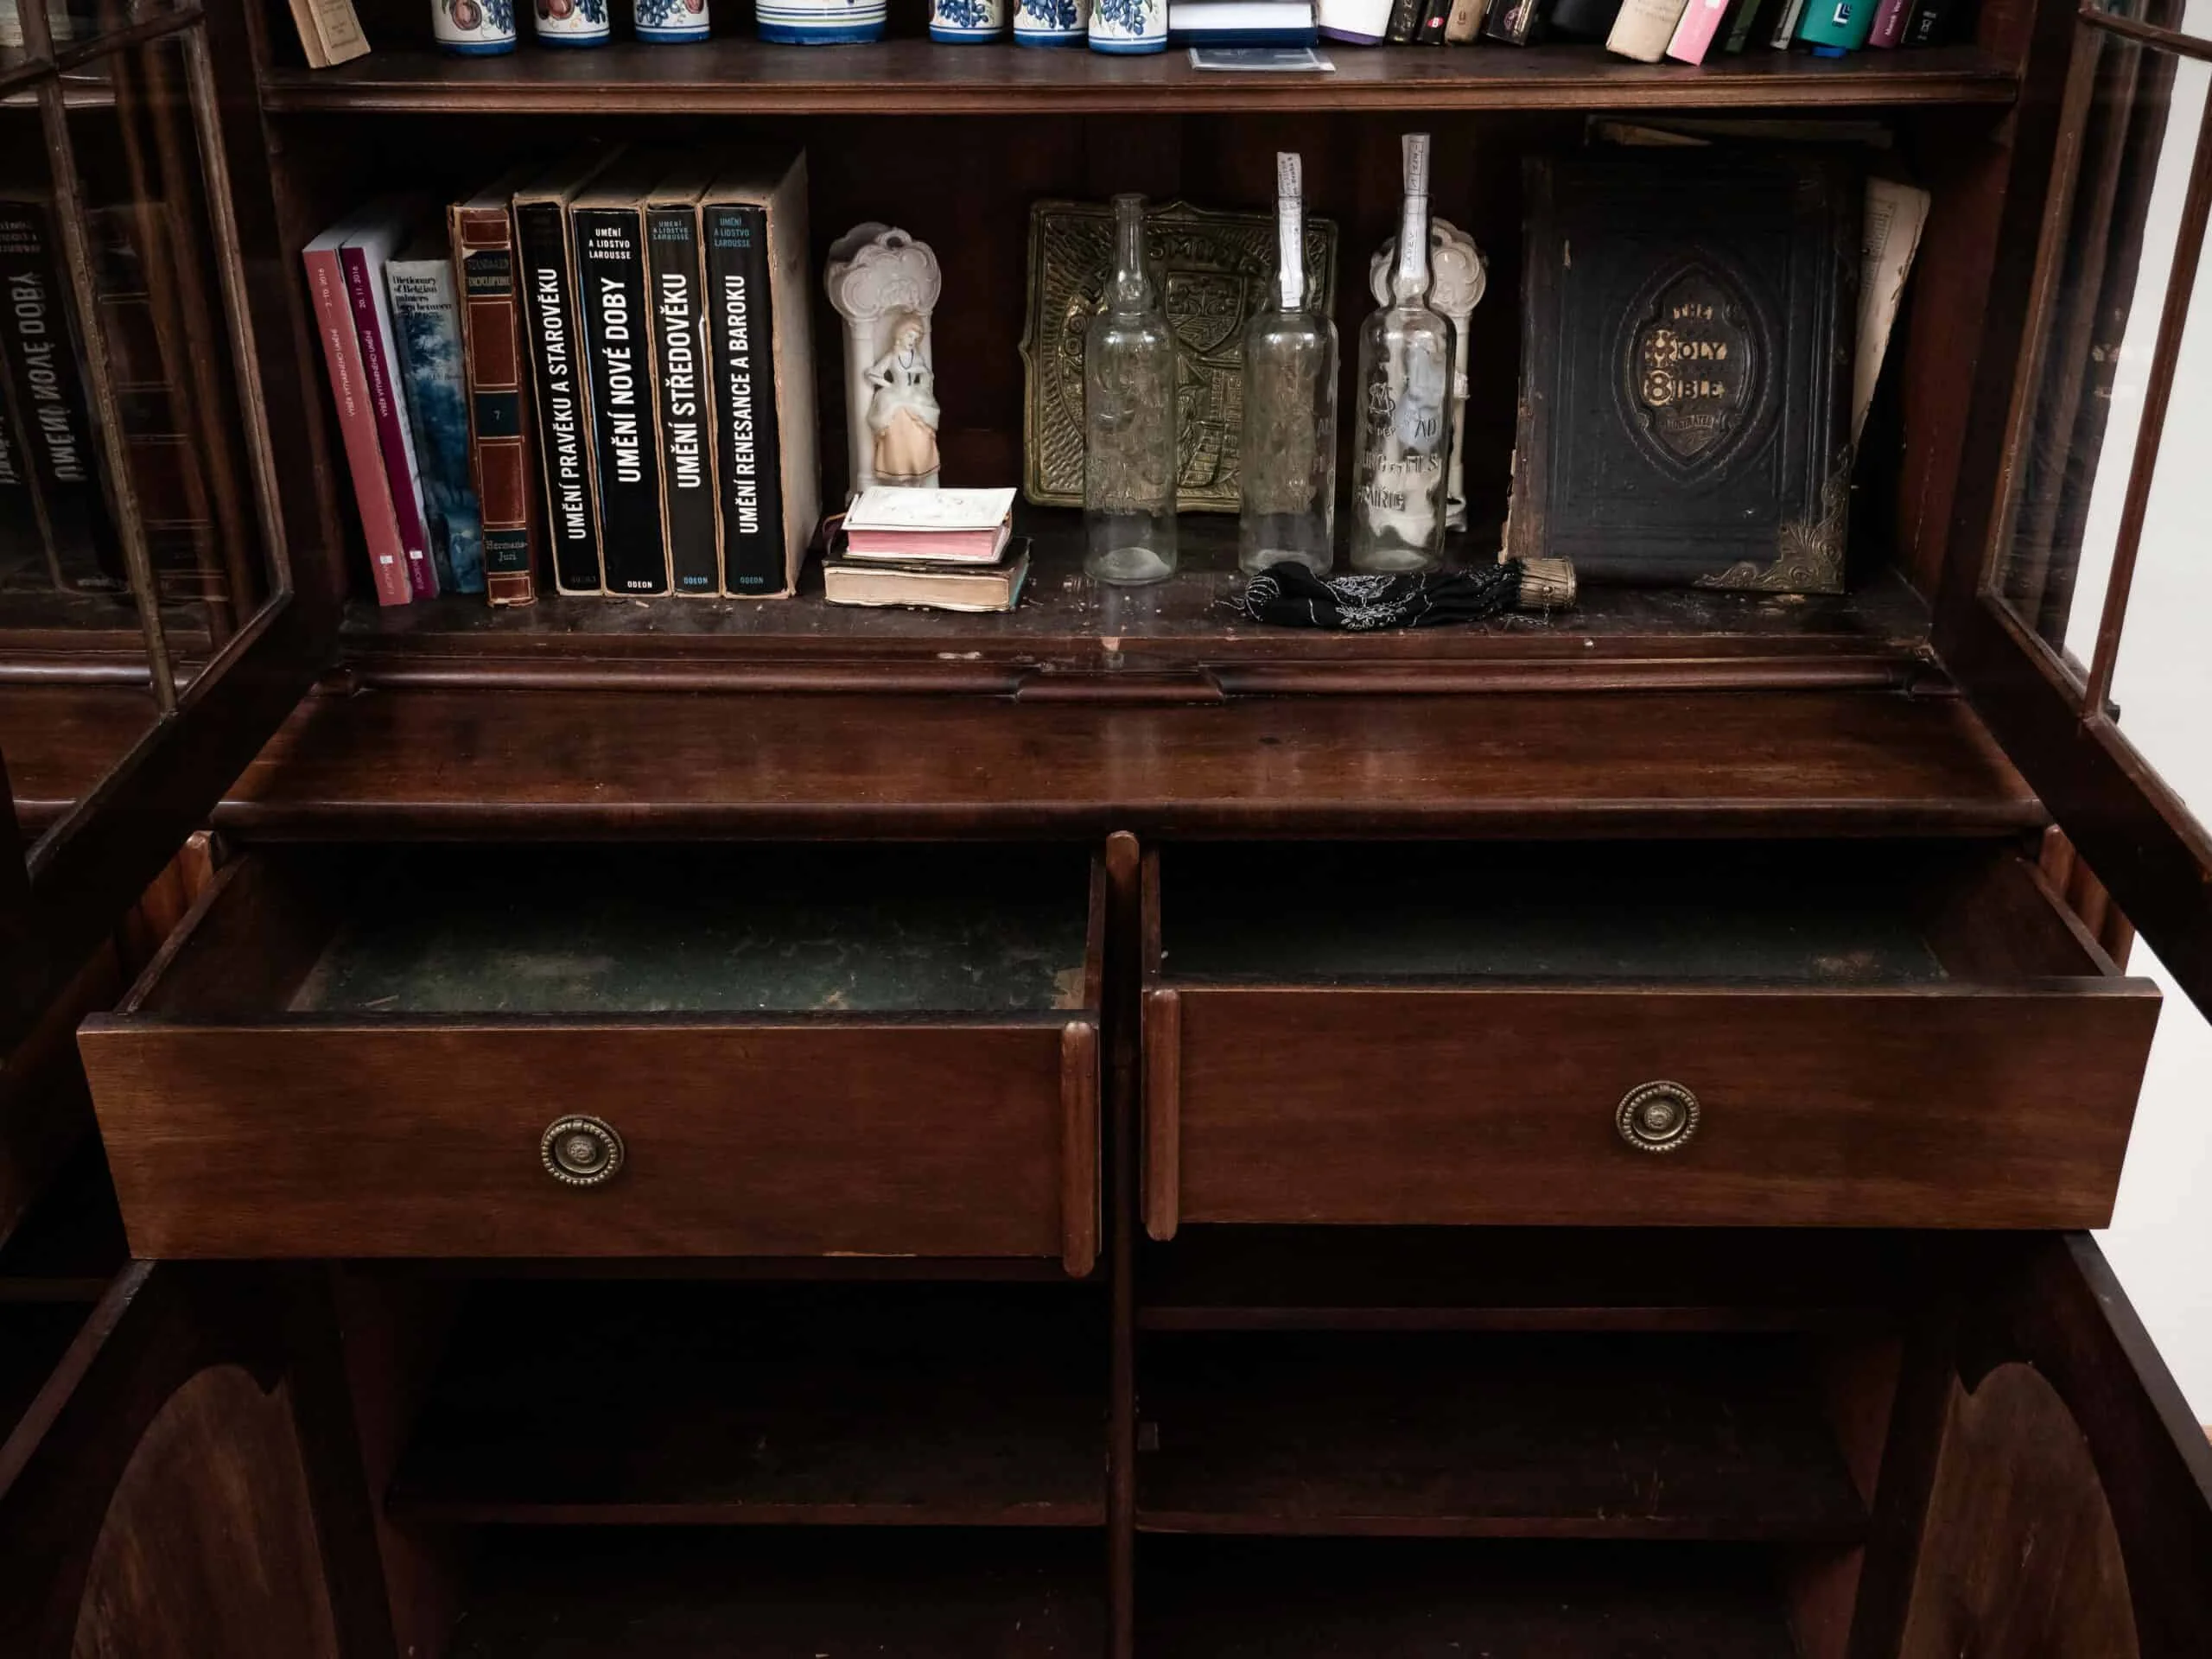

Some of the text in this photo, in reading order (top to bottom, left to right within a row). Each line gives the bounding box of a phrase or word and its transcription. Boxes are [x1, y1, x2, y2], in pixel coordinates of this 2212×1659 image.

[595, 227, 621, 237] UMĚNÍ
[596, 240, 631, 249] LIDSTVO
[714, 239, 751, 248] LAROUSSE
[589, 251, 632, 259] LAROUSSE
[1672, 303, 1714, 320] THE
[1644, 328, 1728, 368] HOLY
[601, 276, 641, 482] UMĚNÍ NOVÉ DOBY
[660, 273, 701, 488] UMĚNÍ STŘEDOVĚKU
[1643, 370, 1726, 406] BIBLE
[537, 269, 587, 539] UMĚNÍ PRAVĚKU A STAROVĚKU
[725, 275, 759, 533] UMĚNÍ RENESANCE A BAROKU
[493, 410, 500, 420] 7
[627, 580, 652, 588] ODEON
[683, 576, 709, 585] ODEON
